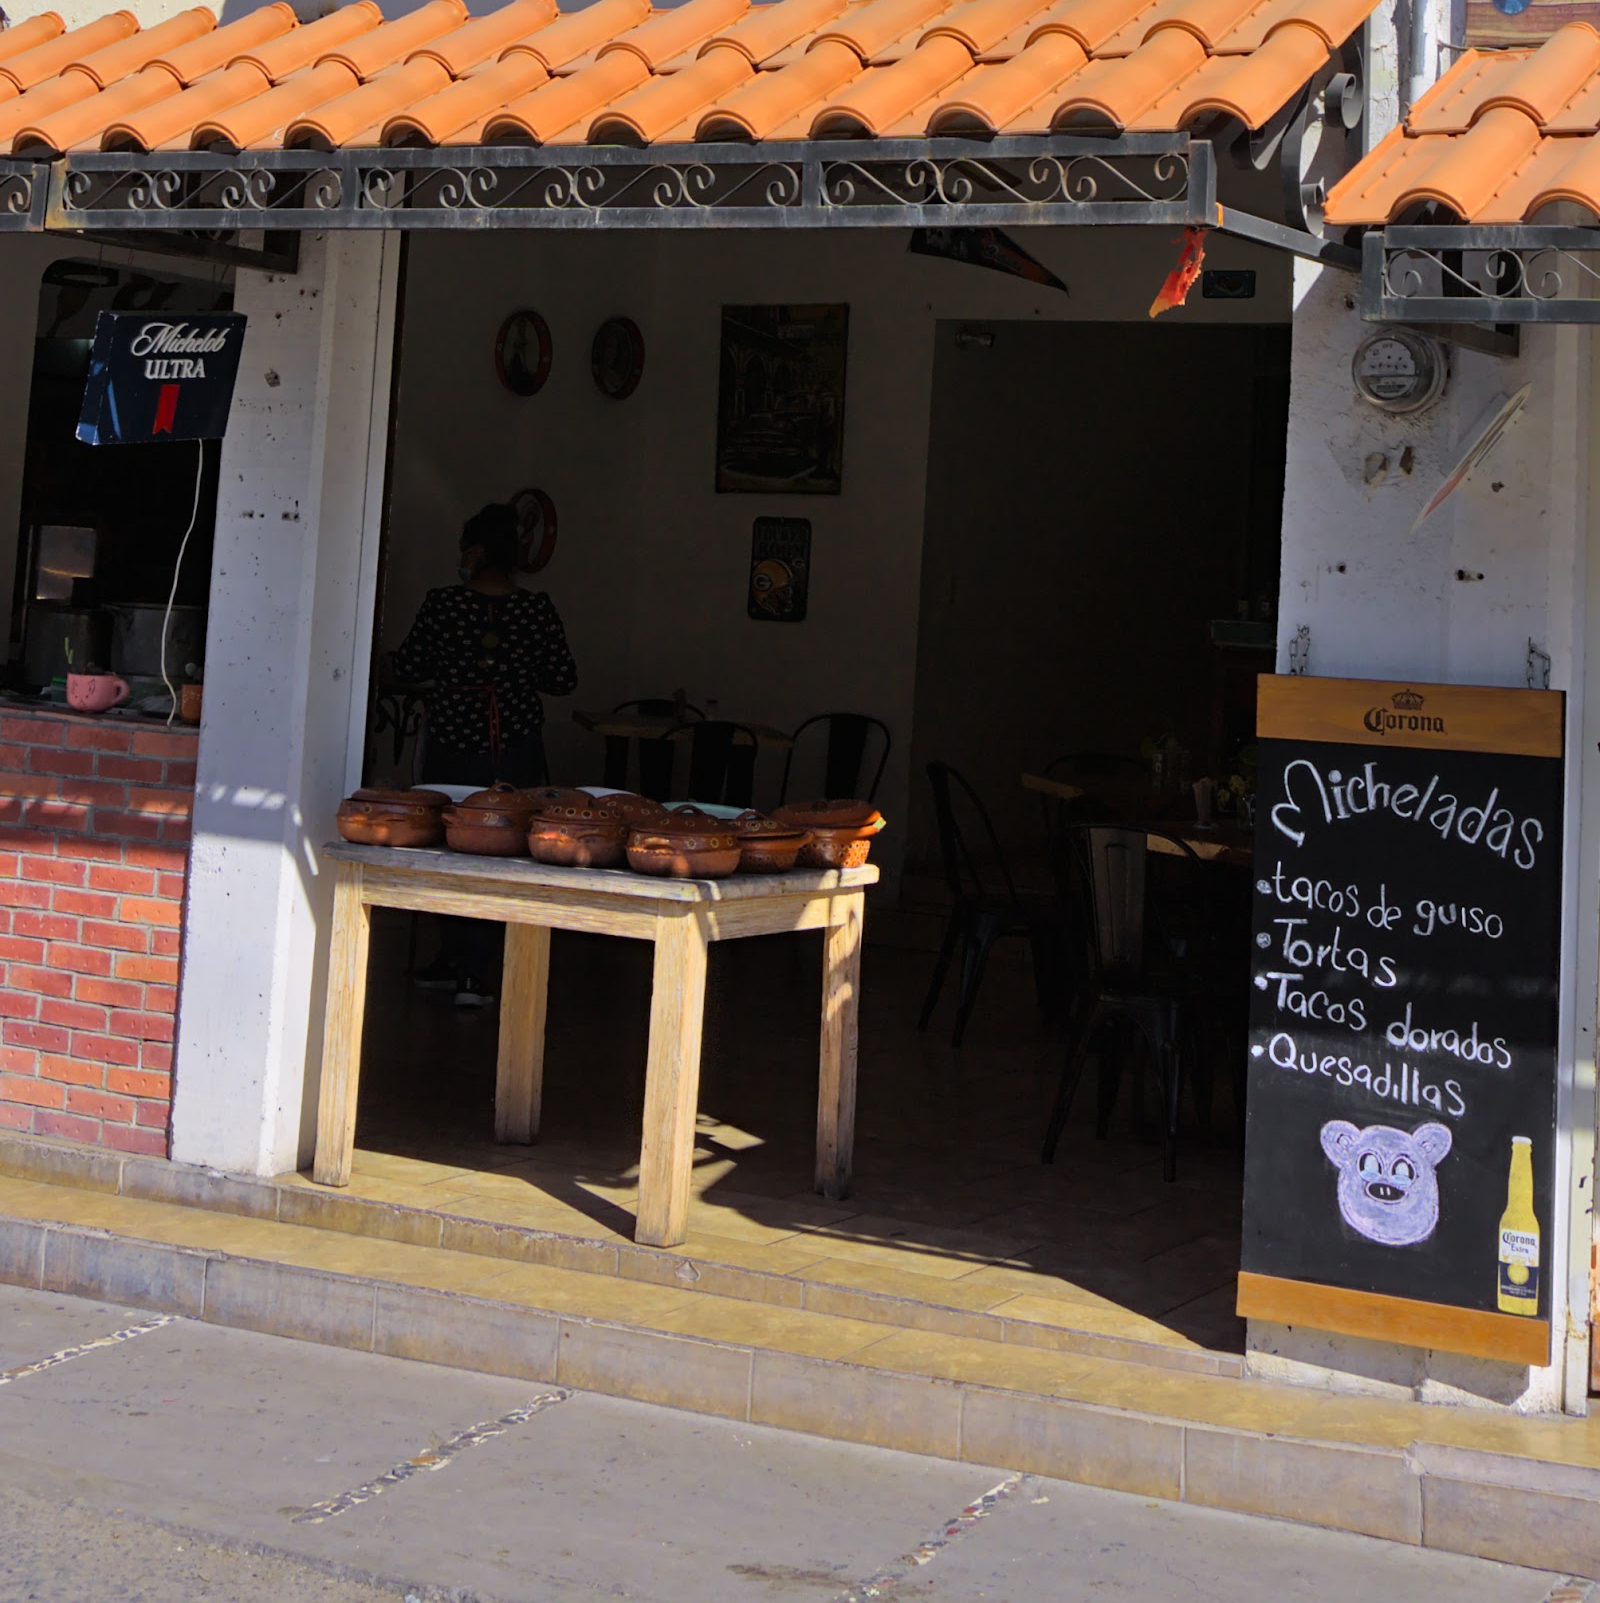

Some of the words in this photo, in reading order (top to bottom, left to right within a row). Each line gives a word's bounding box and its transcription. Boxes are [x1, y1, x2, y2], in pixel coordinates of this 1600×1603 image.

[130, 322, 230, 357] Michelob
[144, 358, 206, 379] ULTRA
[1363, 707, 1444, 736] Corona
[1270, 759, 1542, 869] Micheladas
[1271, 860, 1360, 918] tacos
[1366, 884, 1401, 930] de
[1413, 900, 1503, 939] guiso
[1273, 918, 1397, 987] Tortas
[1266, 972, 1367, 1031] Tacos
[1386, 1002, 1512, 1069] dorados
[1268, 1032, 1466, 1116] Quesadillas
[1502, 1232, 1537, 1249] Corona
[1510, 1244, 1530, 1254] Extra
